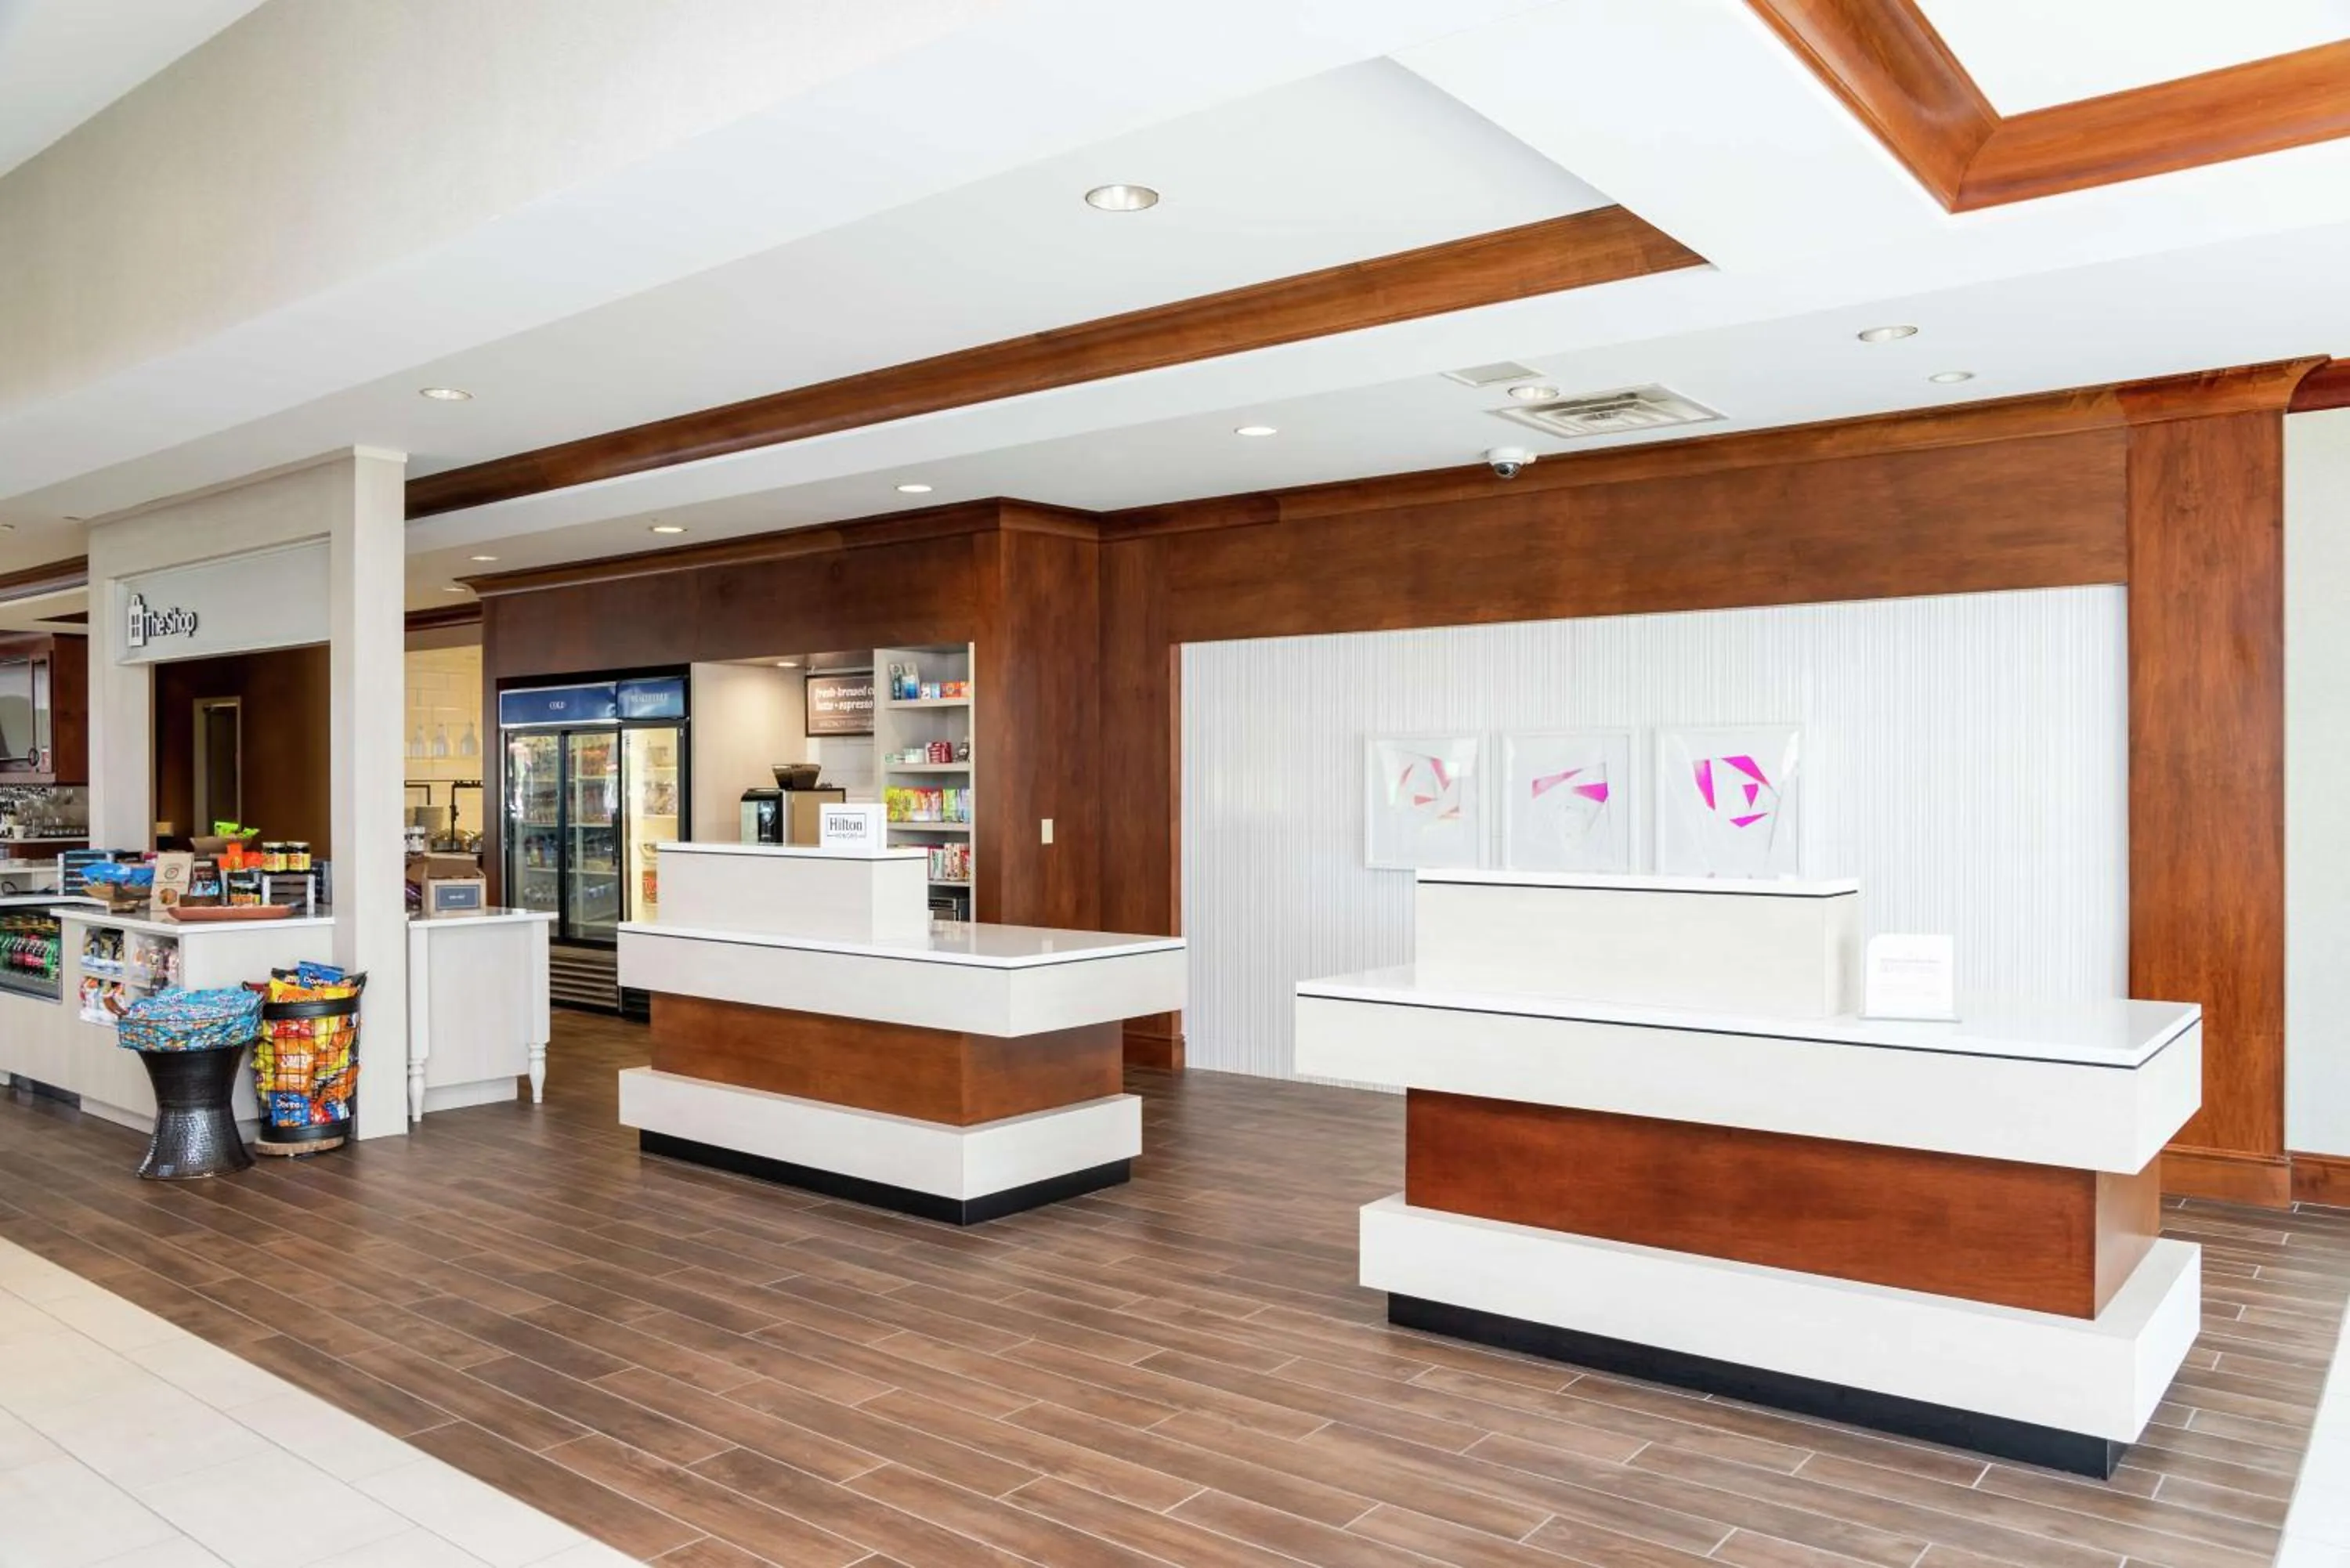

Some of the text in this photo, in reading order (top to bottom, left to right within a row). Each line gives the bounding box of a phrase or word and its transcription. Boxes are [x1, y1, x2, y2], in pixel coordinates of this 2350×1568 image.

[143, 608, 197, 638] The Shop
[839, 700, 873, 713] espresso
[830, 817, 862, 831] Hilton
